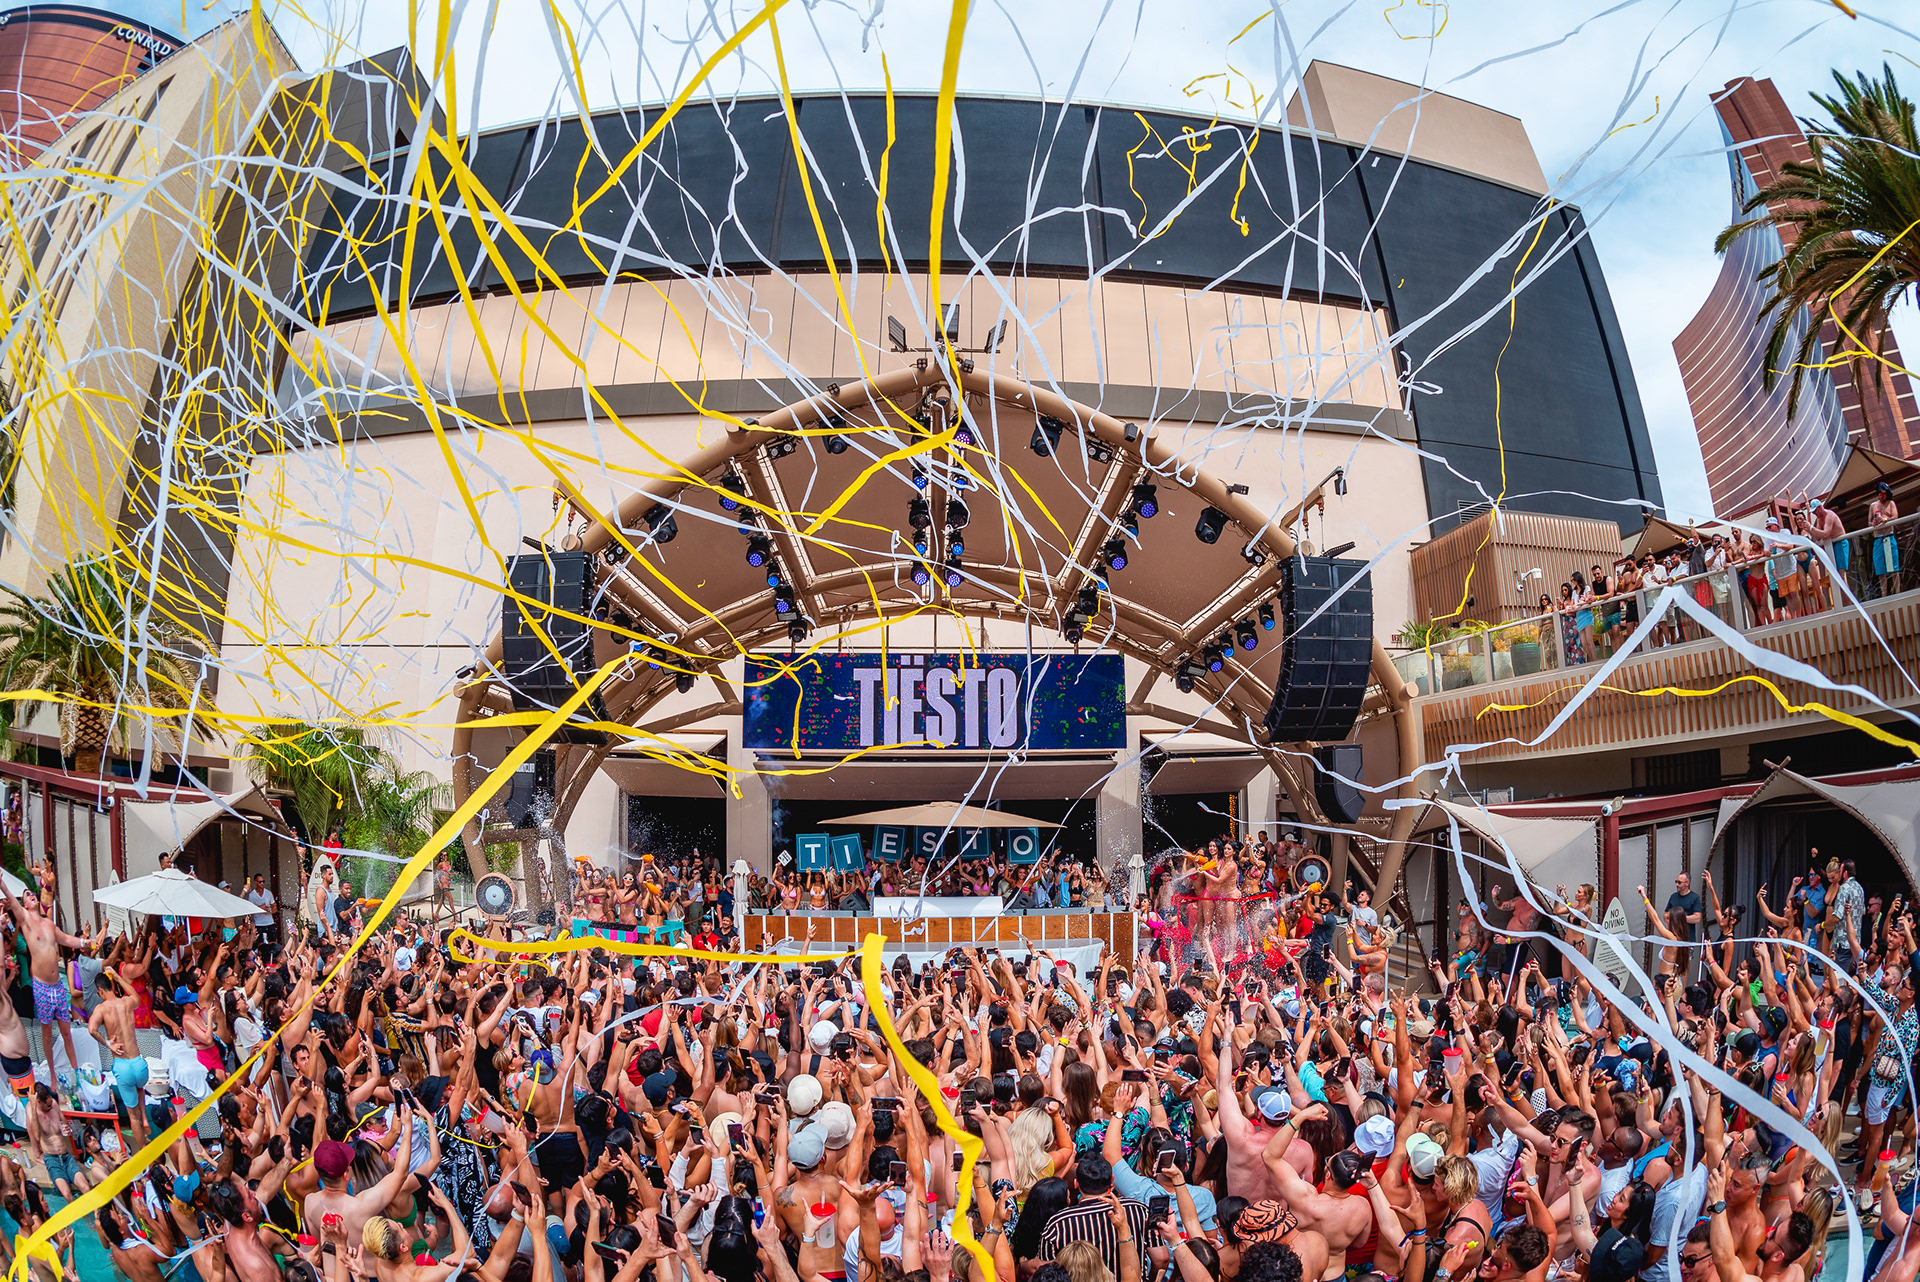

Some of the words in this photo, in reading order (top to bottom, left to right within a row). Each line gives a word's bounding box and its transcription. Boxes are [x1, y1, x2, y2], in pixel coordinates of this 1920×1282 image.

[117, 27, 171, 56] CONRAD
[853, 654, 1018, 748] TIËSTO
[1604, 917, 1625, 930] DIVING
[1610, 908, 1620, 919] NO
